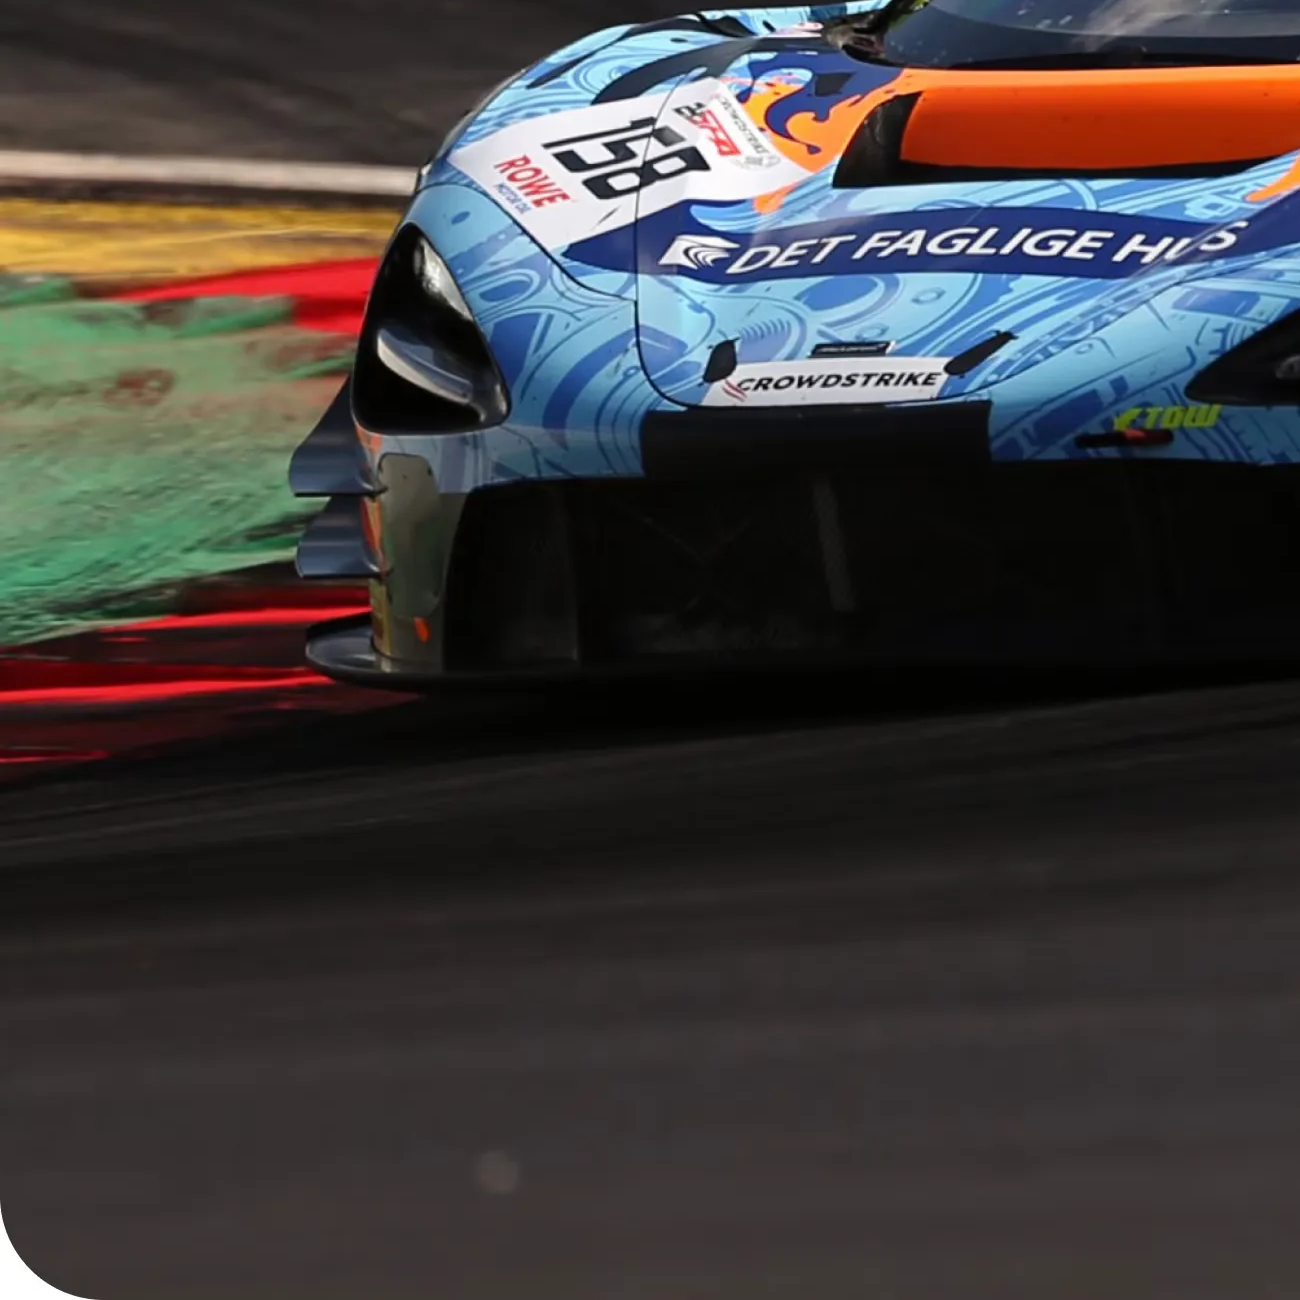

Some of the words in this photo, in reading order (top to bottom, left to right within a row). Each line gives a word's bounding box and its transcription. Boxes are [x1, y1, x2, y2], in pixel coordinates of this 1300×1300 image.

[494, 155, 571, 208] ROWE
[541, 116, 711, 200] 158
[725, 234, 857, 274] DET
[851, 226, 1115, 260] FAGLIGE
[737, 372, 941, 391] CROWDSTRIKE
[1145, 403, 1222, 429] TOW
